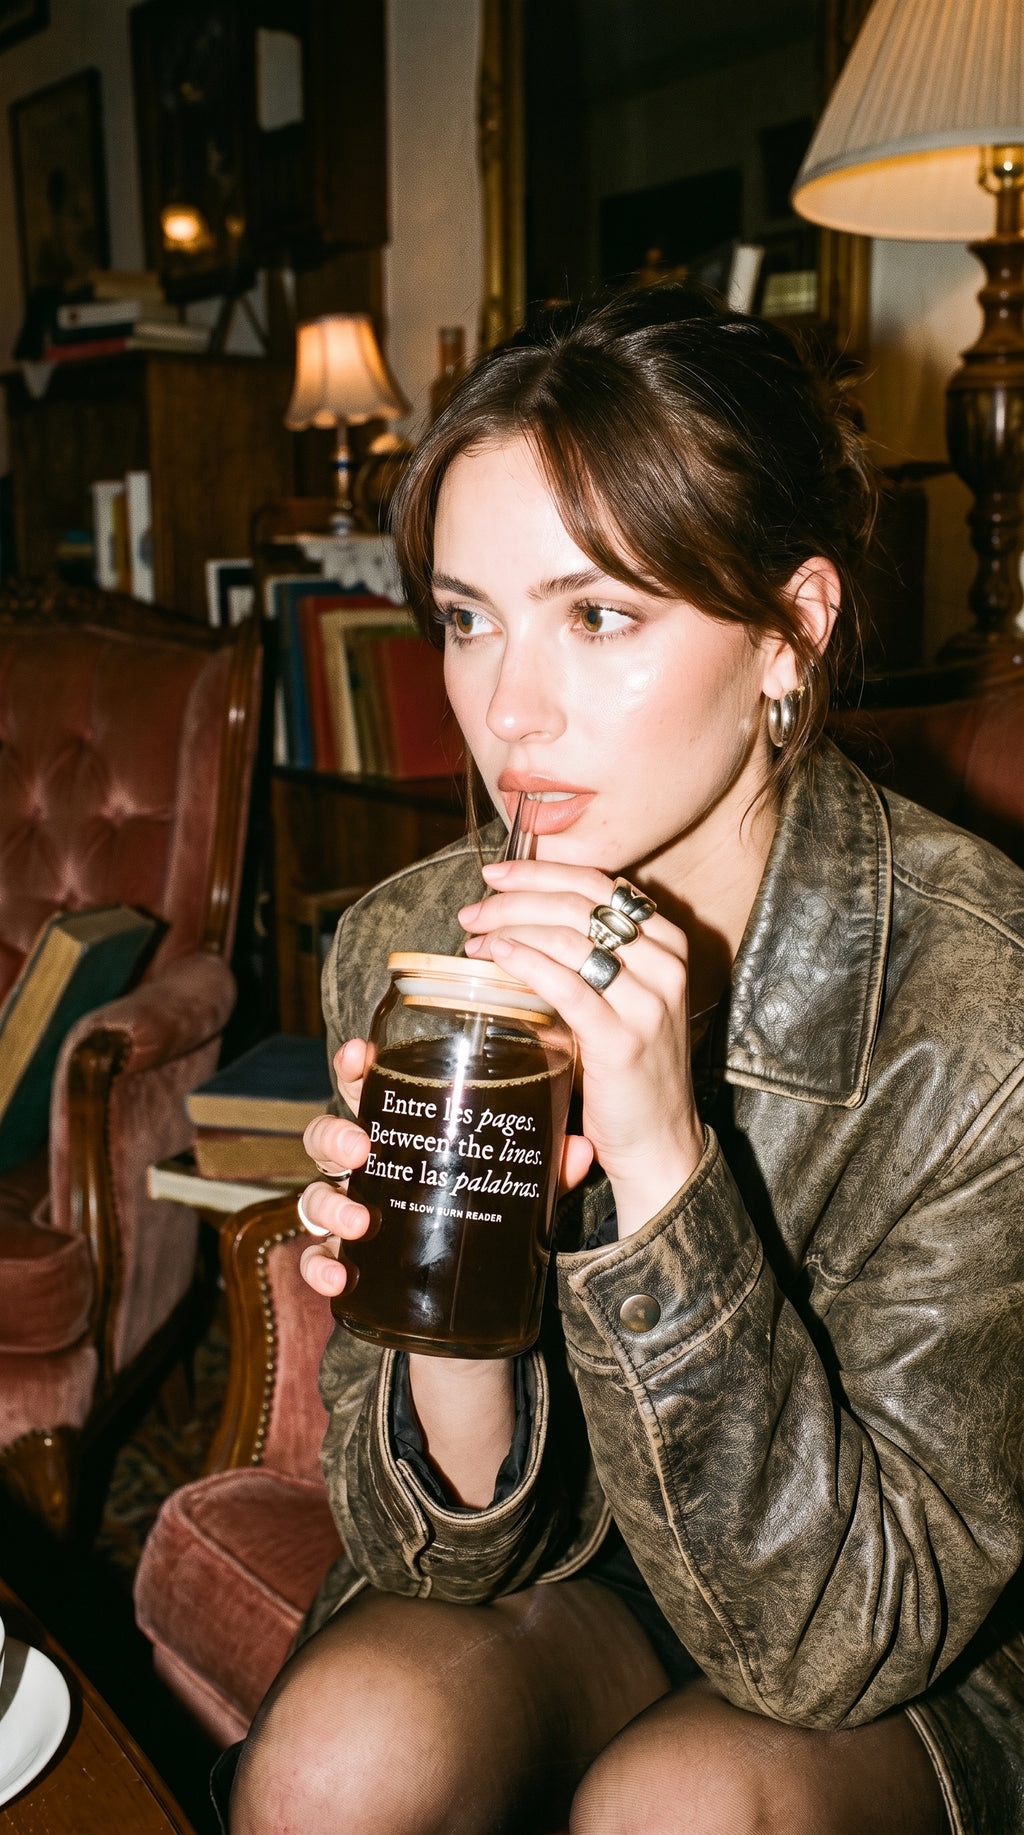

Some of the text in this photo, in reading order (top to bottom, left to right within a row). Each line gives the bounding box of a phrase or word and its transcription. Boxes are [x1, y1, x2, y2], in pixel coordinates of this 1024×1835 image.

[382, 1090, 437, 1119] Entre
[475, 1108, 536, 1137] pages.
[370, 1121, 542, 1165] Between the lines.
[365, 1152, 540, 1198] Entre las palabras.
[390, 1199, 502, 1223] THE SLOW BURN READER
